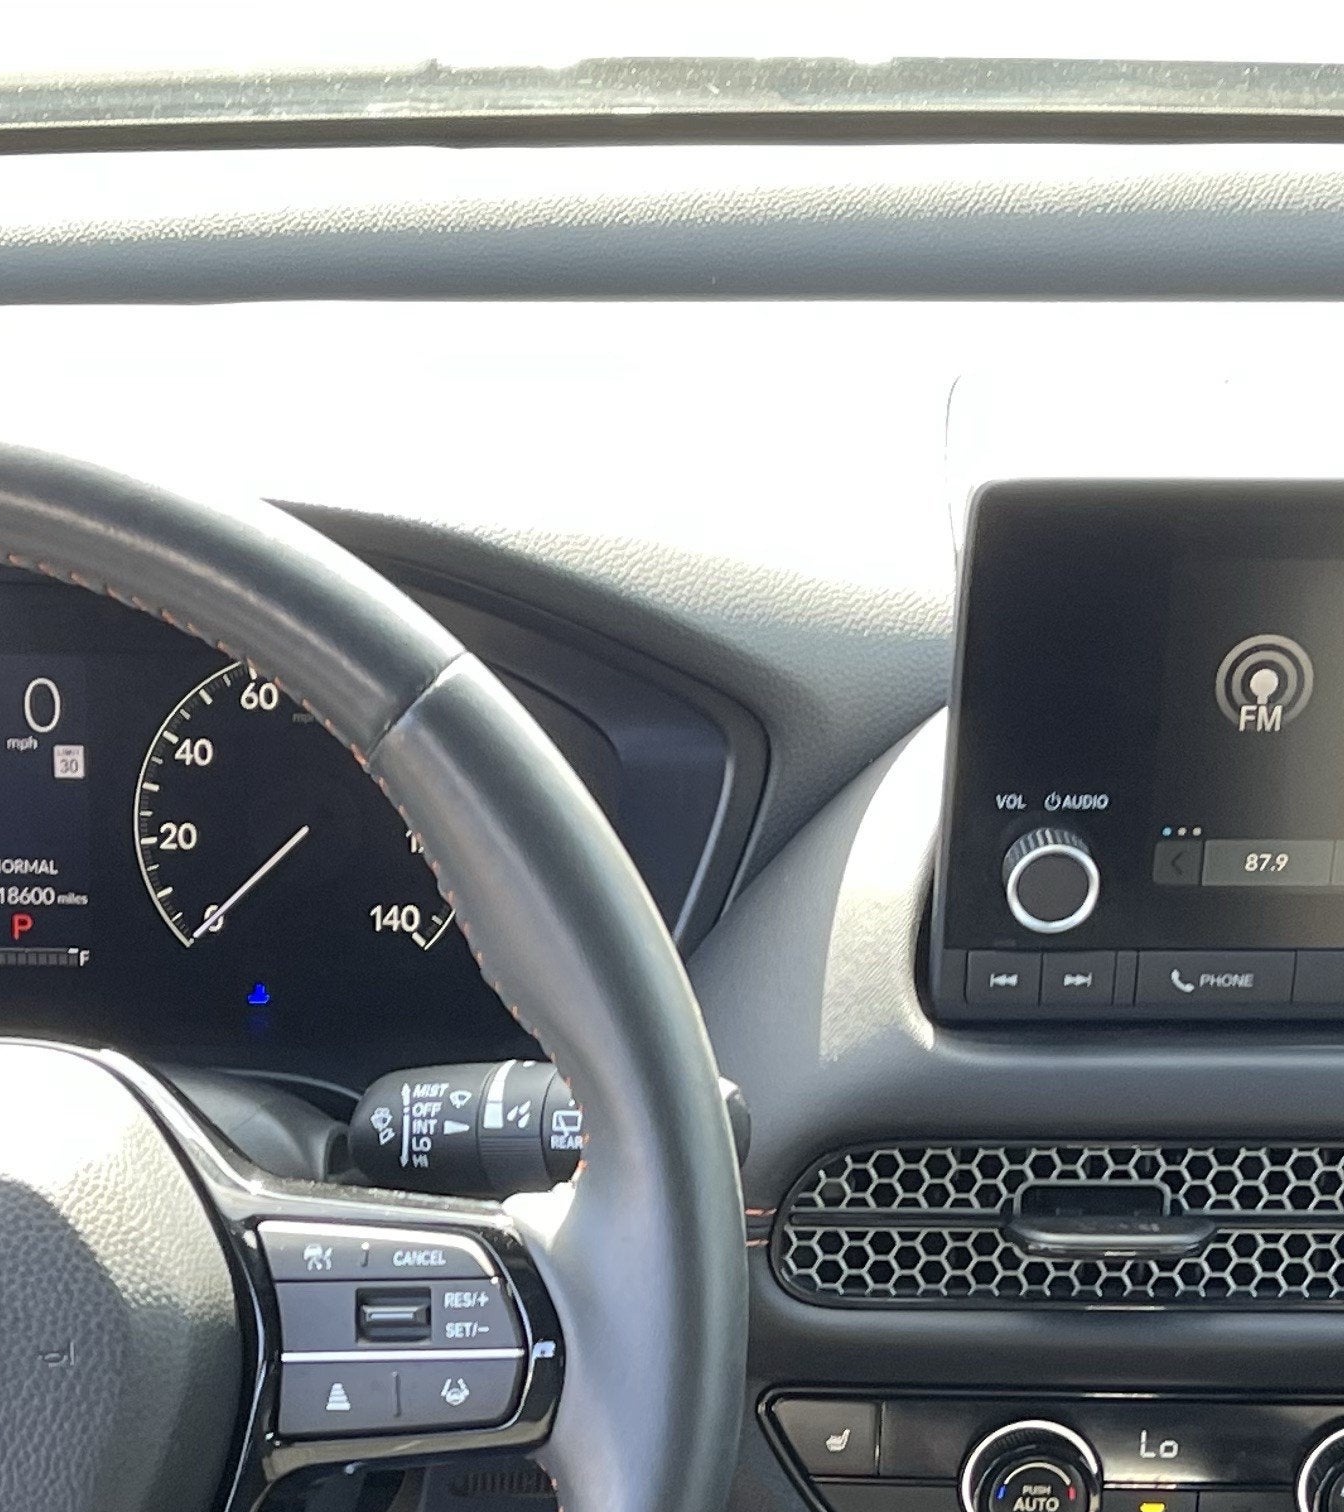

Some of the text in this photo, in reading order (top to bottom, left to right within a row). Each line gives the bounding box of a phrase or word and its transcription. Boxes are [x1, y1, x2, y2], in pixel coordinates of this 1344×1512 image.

[240, 681, 279, 710] 60
[24, 677, 61, 733] 0
[1238, 705, 1284, 732] FM
[6, 736, 38, 751] mph
[174, 738, 214, 766] 40
[59, 759, 79, 775] 30
[996, 794, 1110, 811] VOL AUDIO
[159, 823, 198, 850] 20
[1244, 853, 1289, 873] 87.9
[57, 892, 89, 905] miles
[10, 912, 34, 940] P
[369, 904, 421, 933] 140
[1200, 973, 1254, 989] PHONE
[413, 1082, 449, 1098] MIST
[412, 1101, 443, 1118] OFF
[412, 1118, 438, 1135] INT
[412, 1136, 432, 1152] LO
[551, 1135, 584, 1150] REAR
[392, 1250, 447, 1268] CANCEL
[1140, 1429, 1179, 1459] Lo
[1012, 1496, 1060, 1512] AUTO
